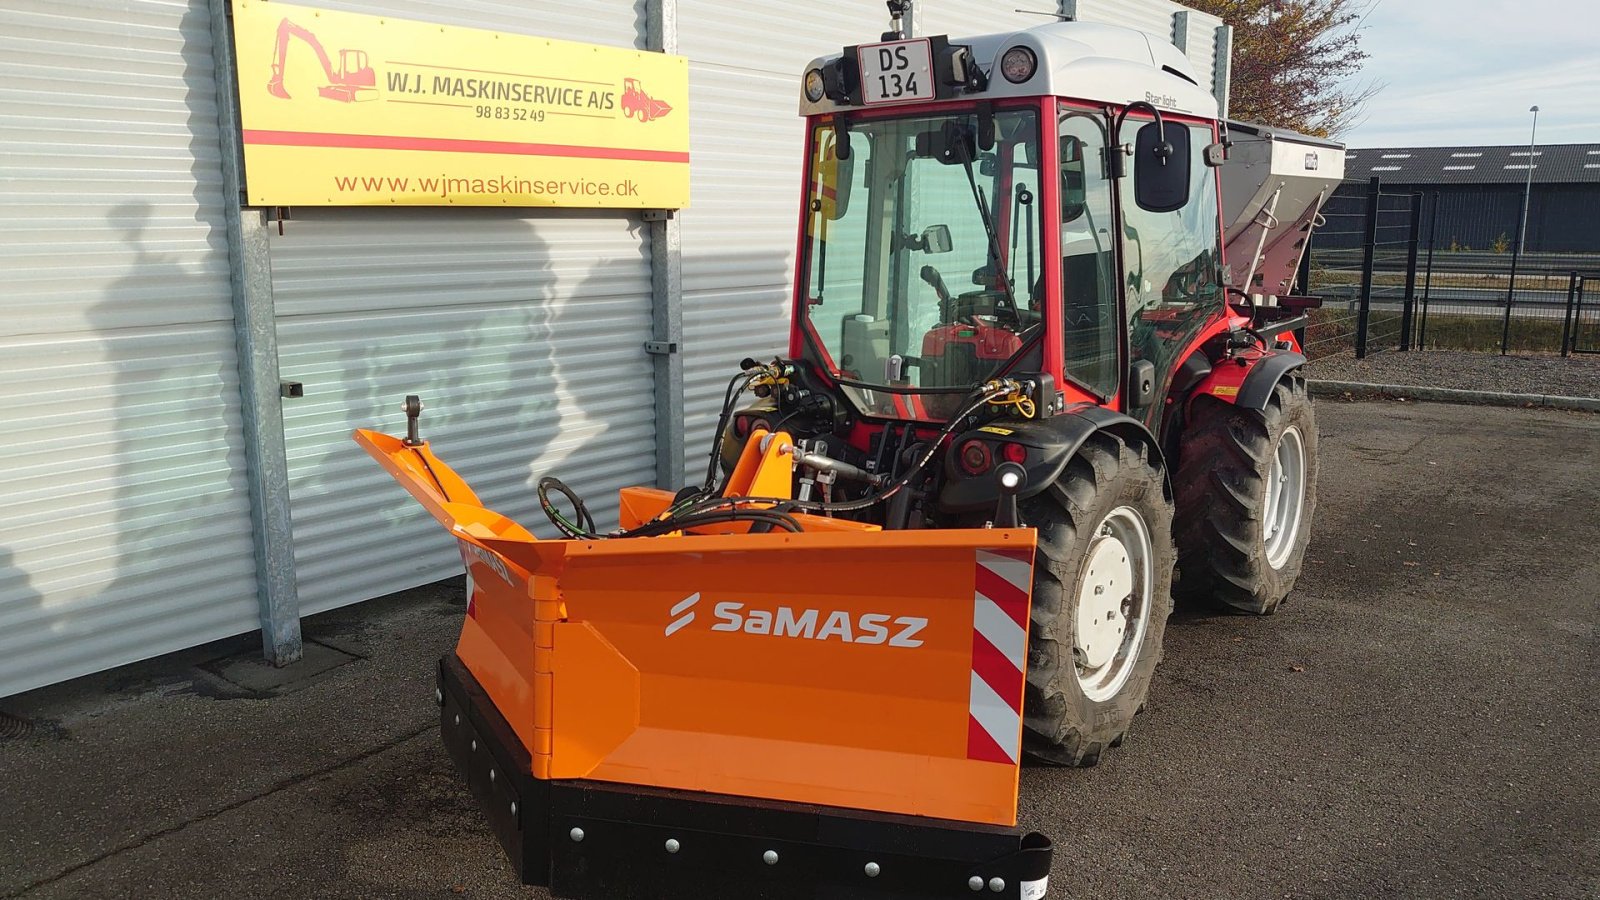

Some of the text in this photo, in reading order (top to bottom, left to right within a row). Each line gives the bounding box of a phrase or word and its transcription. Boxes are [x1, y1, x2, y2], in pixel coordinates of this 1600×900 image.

[879, 46, 909, 71] DS
[387, 71, 614, 110] W.J. MASKINSERVICE A/S
[878, 72, 918, 98] 134
[476, 105, 545, 122] 98 83 52 49
[334, 173, 639, 198] www.wjmaskinservice.dk
[711, 601, 929, 648] SaMASZ
